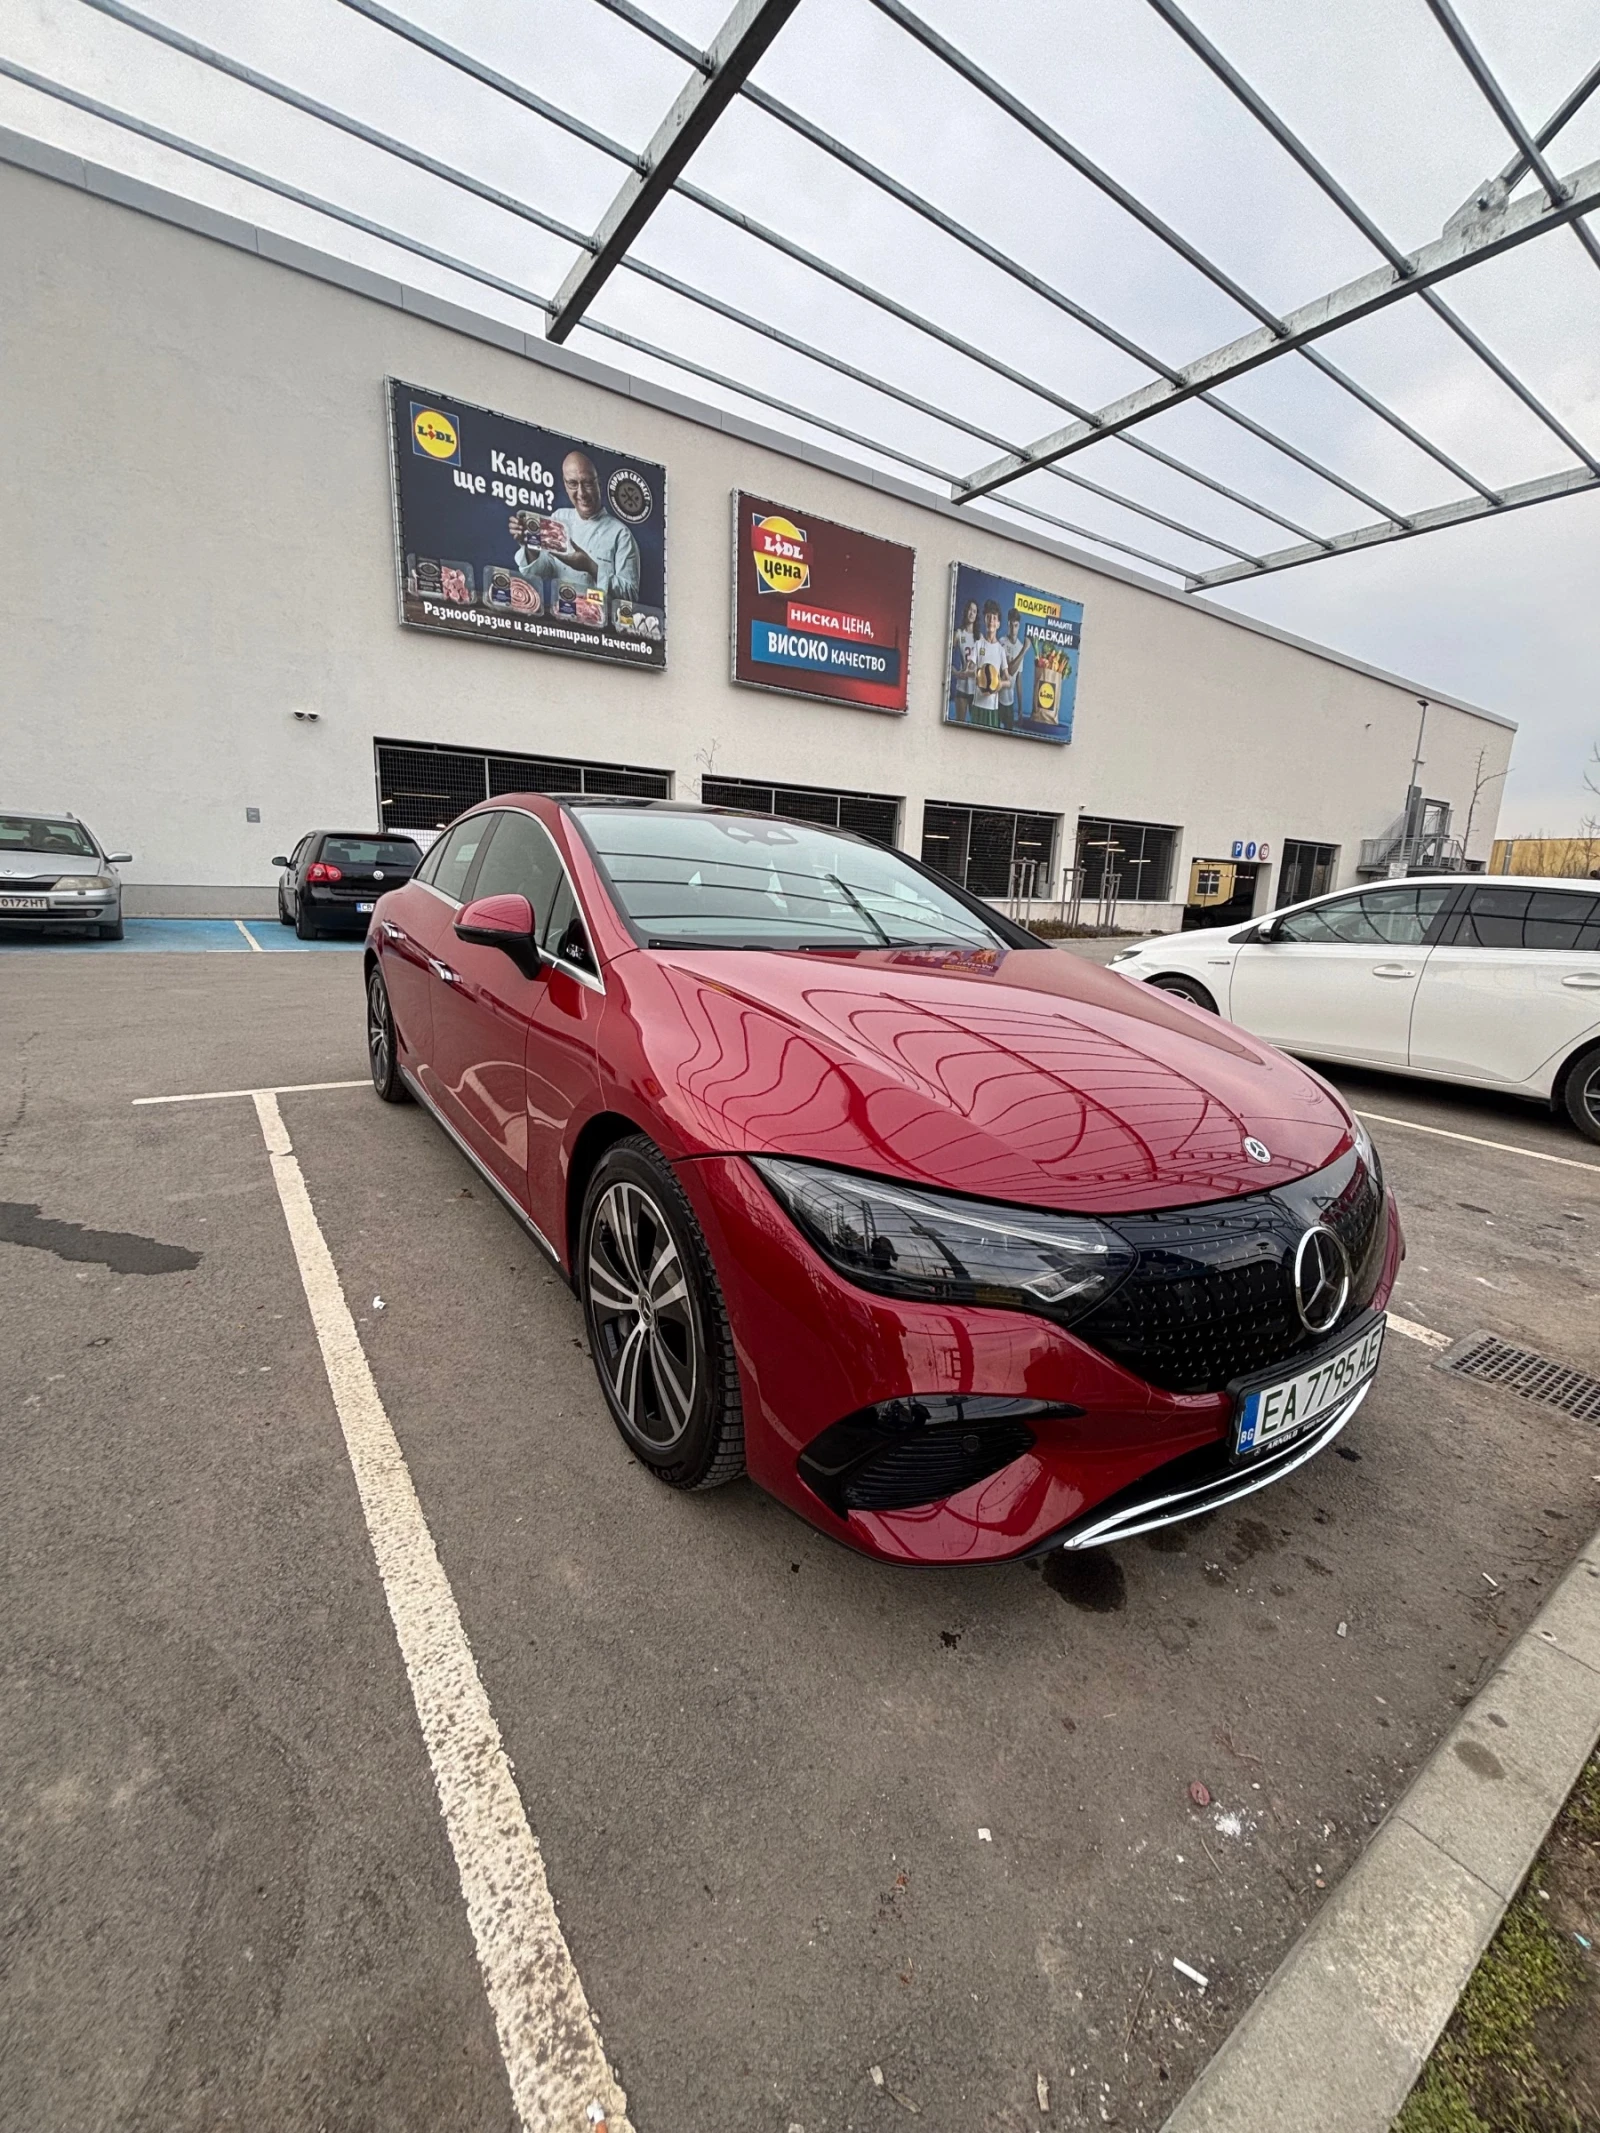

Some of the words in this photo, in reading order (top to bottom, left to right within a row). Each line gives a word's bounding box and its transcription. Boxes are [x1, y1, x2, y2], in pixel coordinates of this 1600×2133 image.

[491, 449, 554, 488] Какво
[453, 469, 486, 495] ще
[491, 480, 555, 511] ядем?
[764, 559, 802, 580] цена
[1017, 597, 1057, 616] ПОДКРЕПИ
[423, 601, 512, 629] Разнообразие
[514, 620, 522, 631] и
[524, 622, 600, 644] гарантирано
[601, 634, 653, 655] качество
[790, 608, 840, 629] НИСКА
[842, 616, 875, 639] ЦЕНА,
[1047, 618, 1073, 631] МЛАДИТЕ
[1026, 624, 1073, 646] НАДЕЖДИ!
[768, 631, 828, 662] ВИСОКО
[831, 649, 886, 672] КАЧЕСТВО
[1235, 843, 1242, 855] P
[1, 898, 29, 908] 0172
[1261, 1383, 1296, 1436] EA
[1302, 1348, 1357, 1416] 7795
[1356, 1328, 1381, 1379] AE
[1240, 1428, 1254, 1444] BG
